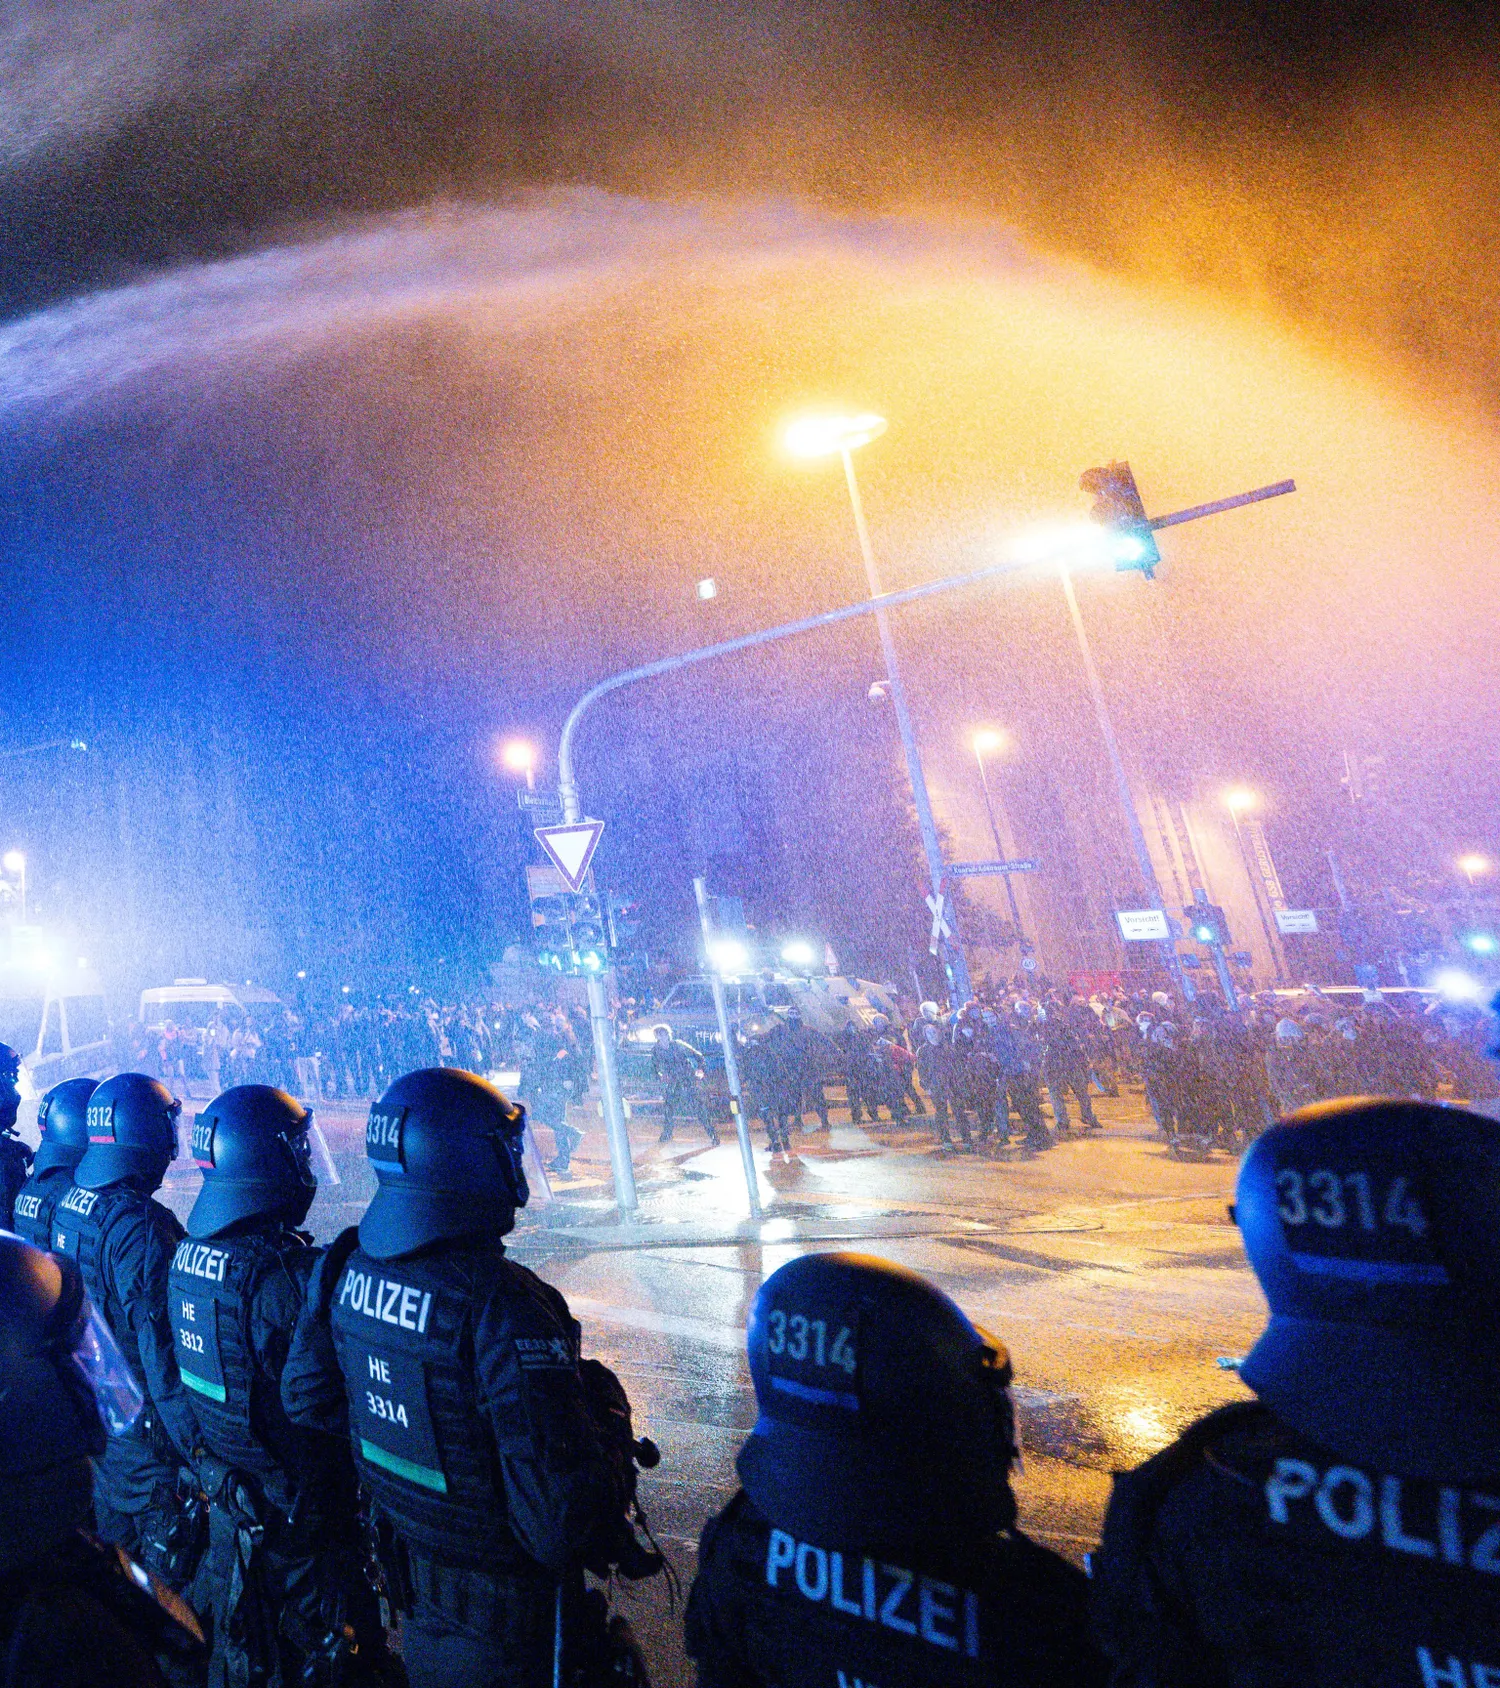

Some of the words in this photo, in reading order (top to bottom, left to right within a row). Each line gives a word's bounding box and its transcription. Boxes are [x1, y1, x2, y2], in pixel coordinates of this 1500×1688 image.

[86, 1106, 113, 1127] 3312
[366, 1113, 400, 1149] 3314
[15, 1193, 41, 1219] OLIZEI
[60, 1187, 99, 1216] OLIZEI
[1276, 1168, 1429, 1237] 3314
[57, 1233, 66, 1250] HE
[171, 1242, 229, 1283] POLIZEI
[181, 1300, 195, 1321] HE
[339, 1268, 432, 1334] POLIZEI
[179, 1328, 204, 1355] 3312
[768, 1309, 858, 1375] 3314
[368, 1354, 392, 1385] HE
[365, 1390, 409, 1429] 3314
[765, 1526, 980, 1659] POLIZEI
